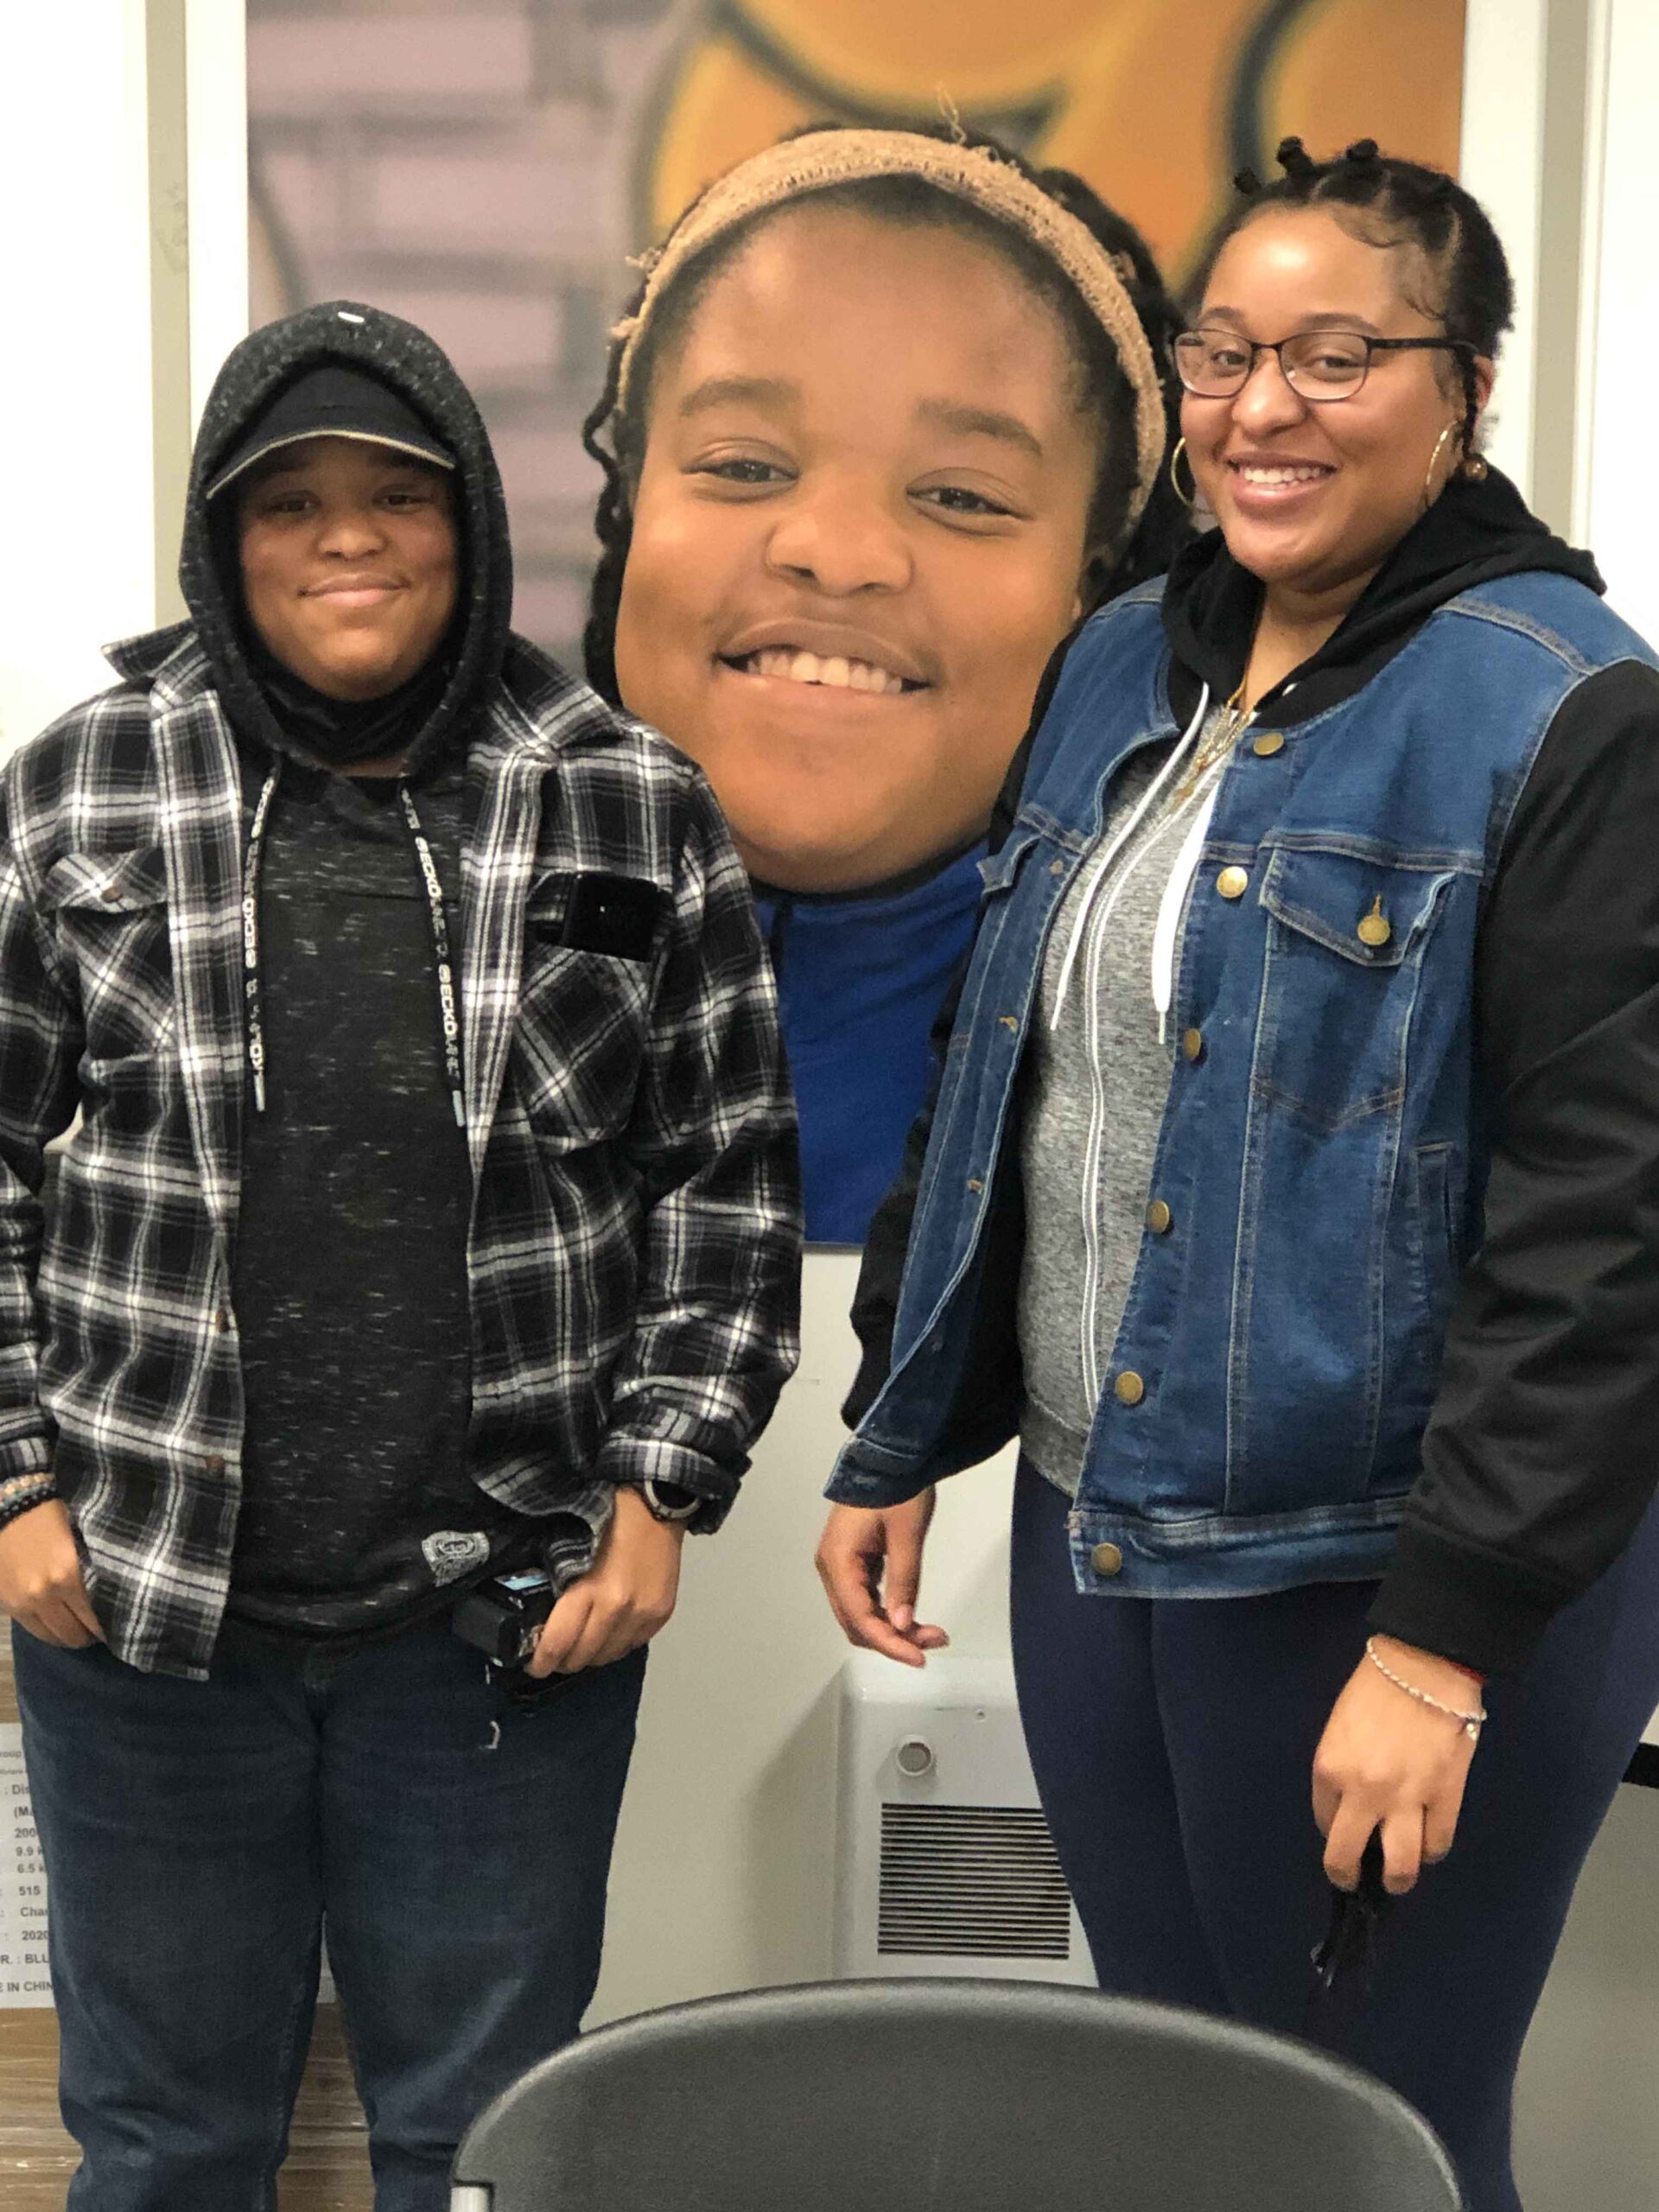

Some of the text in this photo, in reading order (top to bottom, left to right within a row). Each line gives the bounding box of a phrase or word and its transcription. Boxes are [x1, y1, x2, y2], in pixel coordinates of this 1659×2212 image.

[16, 1847, 34, 1857] 9.9
[17, 1864, 36, 1873] 6.5
[19, 1885, 41, 1896] 515
[7, 1982, 20, 1993] IN
